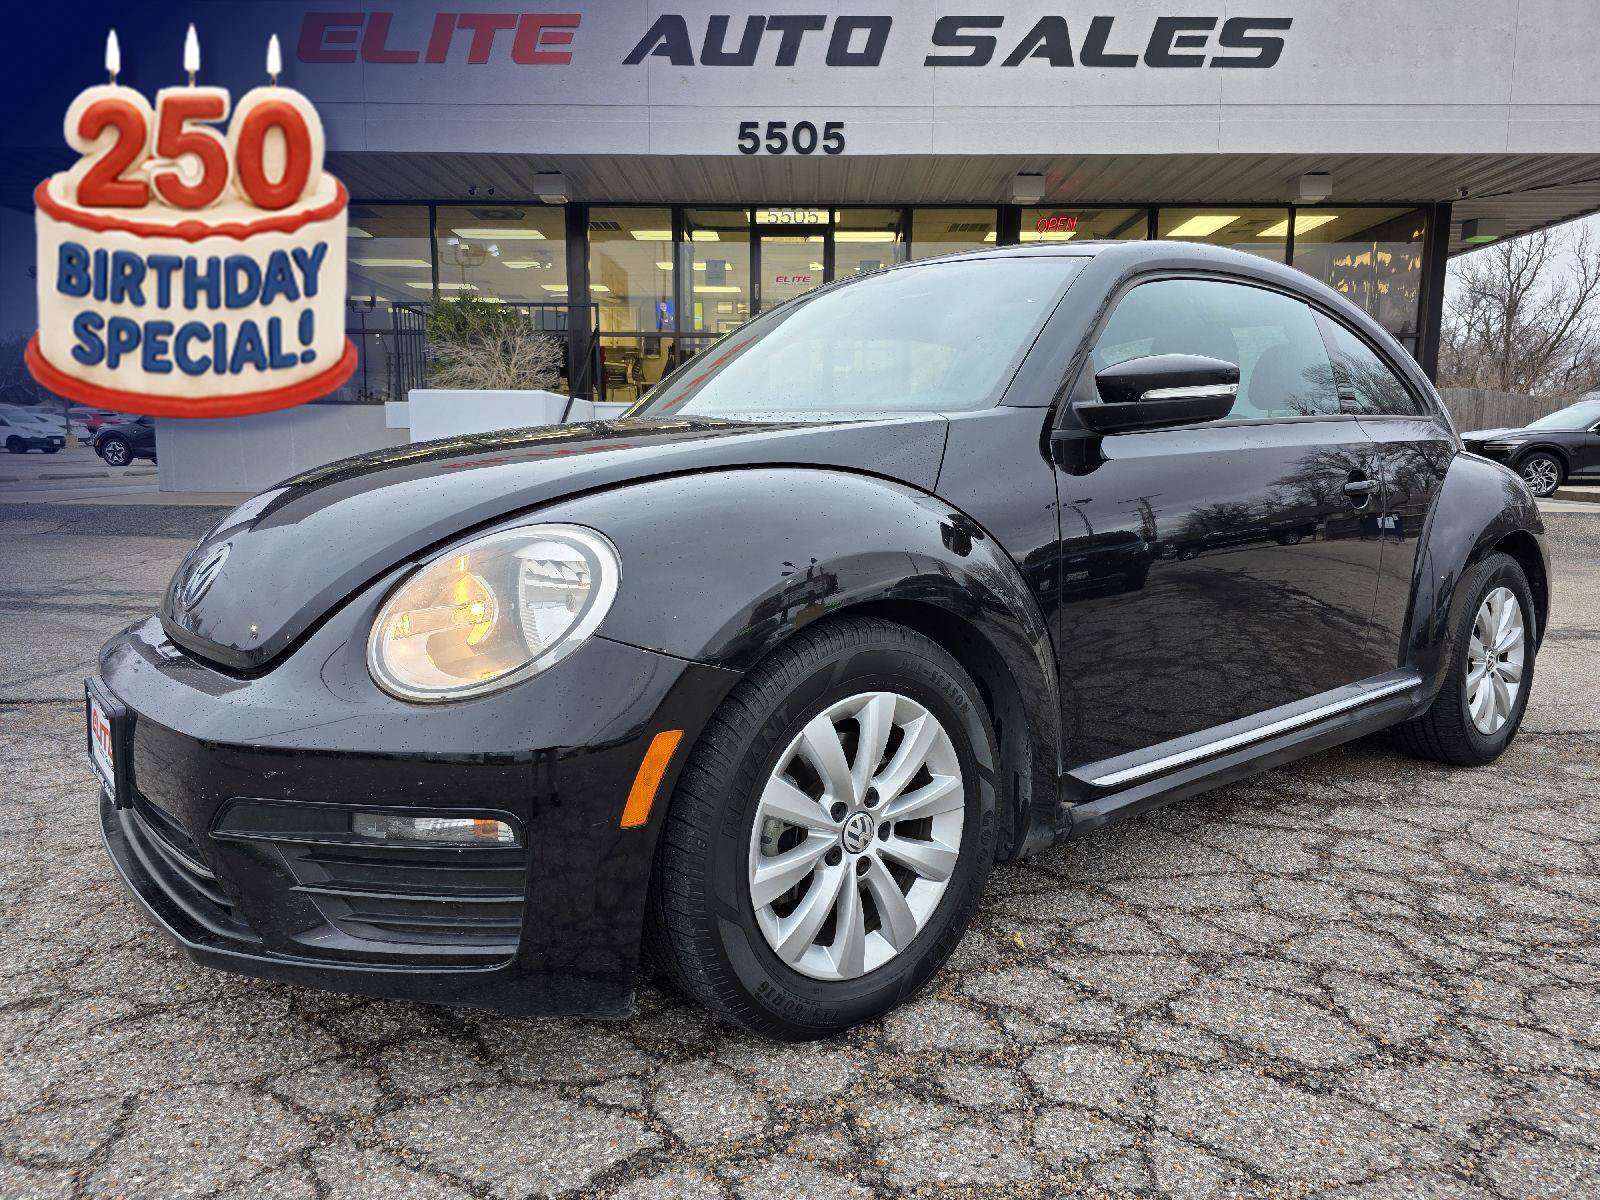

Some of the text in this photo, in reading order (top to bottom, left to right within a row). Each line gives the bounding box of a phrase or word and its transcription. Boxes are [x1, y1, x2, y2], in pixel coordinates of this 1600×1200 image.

[297, 12, 1293, 69] ELITE AUTO SALES
[737, 121, 845, 155] 5505
[767, 208, 819, 224] 5505
[1036, 216, 1079, 233] OPEN
